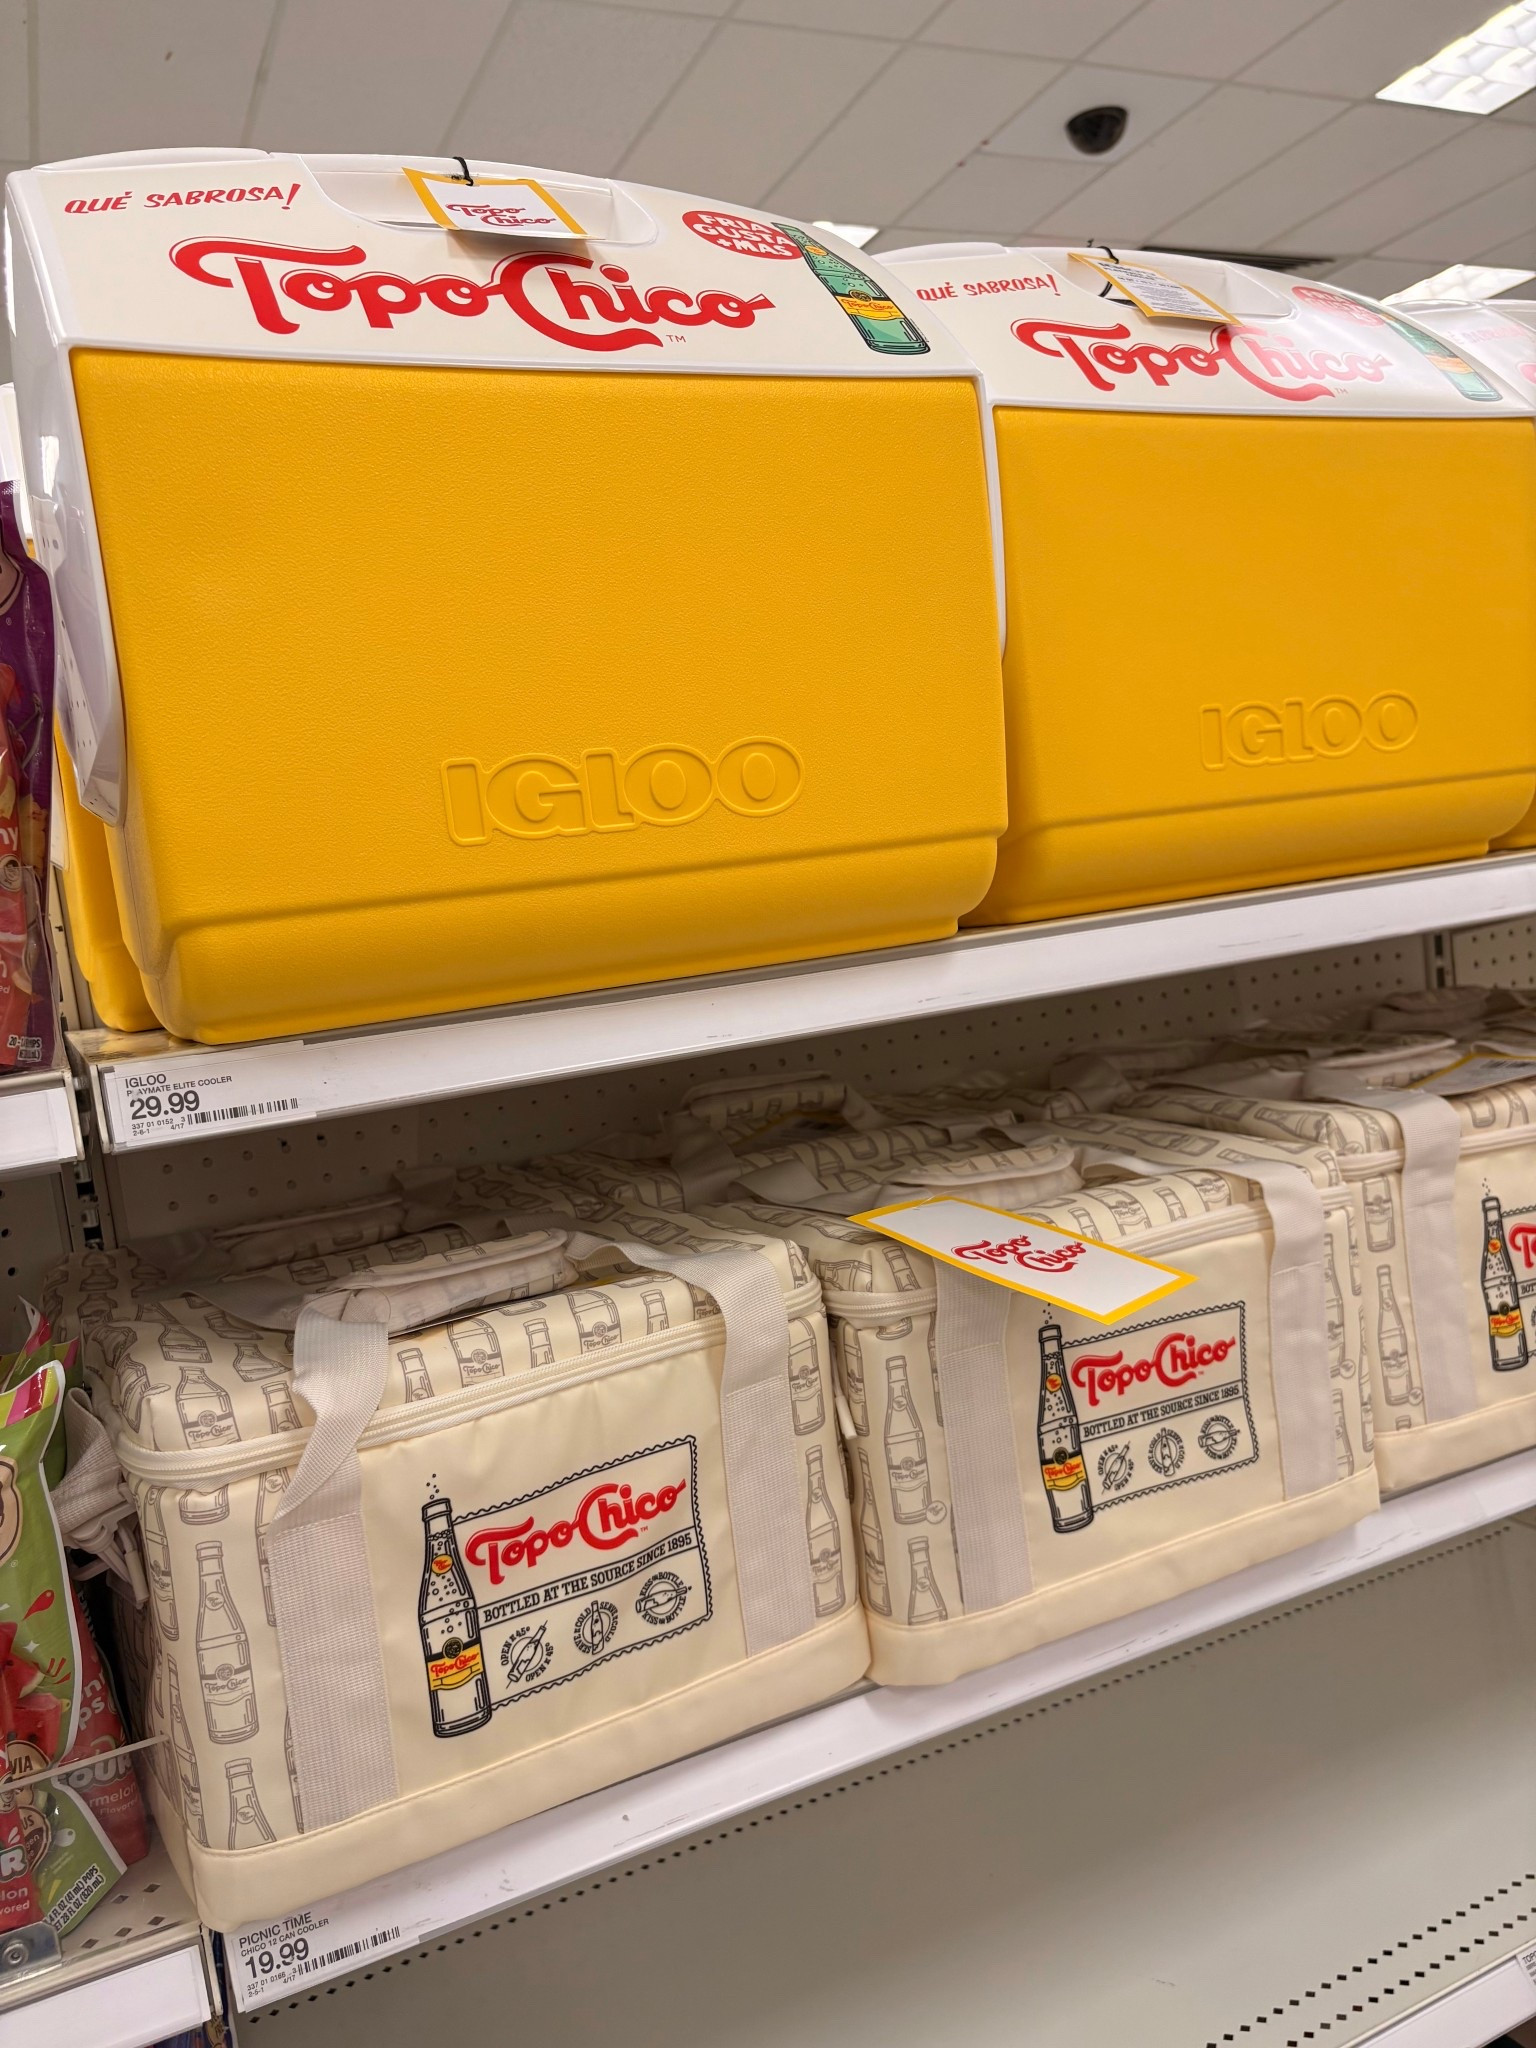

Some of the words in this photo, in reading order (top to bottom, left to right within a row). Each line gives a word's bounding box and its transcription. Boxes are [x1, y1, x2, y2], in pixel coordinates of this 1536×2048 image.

[64, 191, 133, 214] QUÉ
[144, 183, 301, 211] SABROSA!
[445, 203, 527, 217] Topo
[480, 214, 557, 227] Chico
[697, 213, 773, 234] FRIA
[692, 223, 798, 247] GUSTA
[716, 238, 794, 257] +MAS
[916, 282, 957, 301] QUÉ
[963, 273, 1062, 297] SABROSA!
[1201, 690, 1419, 771] IGLOO
[441, 736, 805, 847] IGLOO
[125, 1073, 167, 1089] IGLOO
[126, 1084, 172, 1097] PAYMATE
[173, 1080, 196, 1091] ELITE
[197, 1075, 233, 1087] COOLER
[129, 1089, 200, 1121] 29.99
[131, 1121, 145, 1130] 337
[156, 1117, 174, 1126] 0152
[1083, 1416, 1126, 1438] BOTTLED
[1126, 1411, 1140, 1425] AT
[1139, 1406, 1160, 1422] THE
[1160, 1396, 1194, 1417] SOURCE
[1194, 1389, 1220, 1405] SINCE
[1220, 1384, 1240, 1399] 1895
[483, 1592, 541, 1623] BOTTLED
[543, 1585, 560, 1603] AT
[561, 1575, 589, 1597] THE
[590, 1561, 636, 1590] SOURCE
[636, 1545, 667, 1569] SINCE
[666, 1532, 693, 1554] 1895
[82, 1865, 99, 1884] POPS
[239, 1924, 282, 1949] PICNIC
[282, 1911, 313, 1931] TIME
[240, 1943, 267, 1958] CHICO
[267, 1938, 278, 1947] 12
[278, 1932, 297, 1943] CAN
[297, 1918, 330, 1935] COOLER
[245, 1937, 310, 1979] 19.99
[247, 1982, 259, 1992] 337
[260, 1978, 269, 1986] 01
